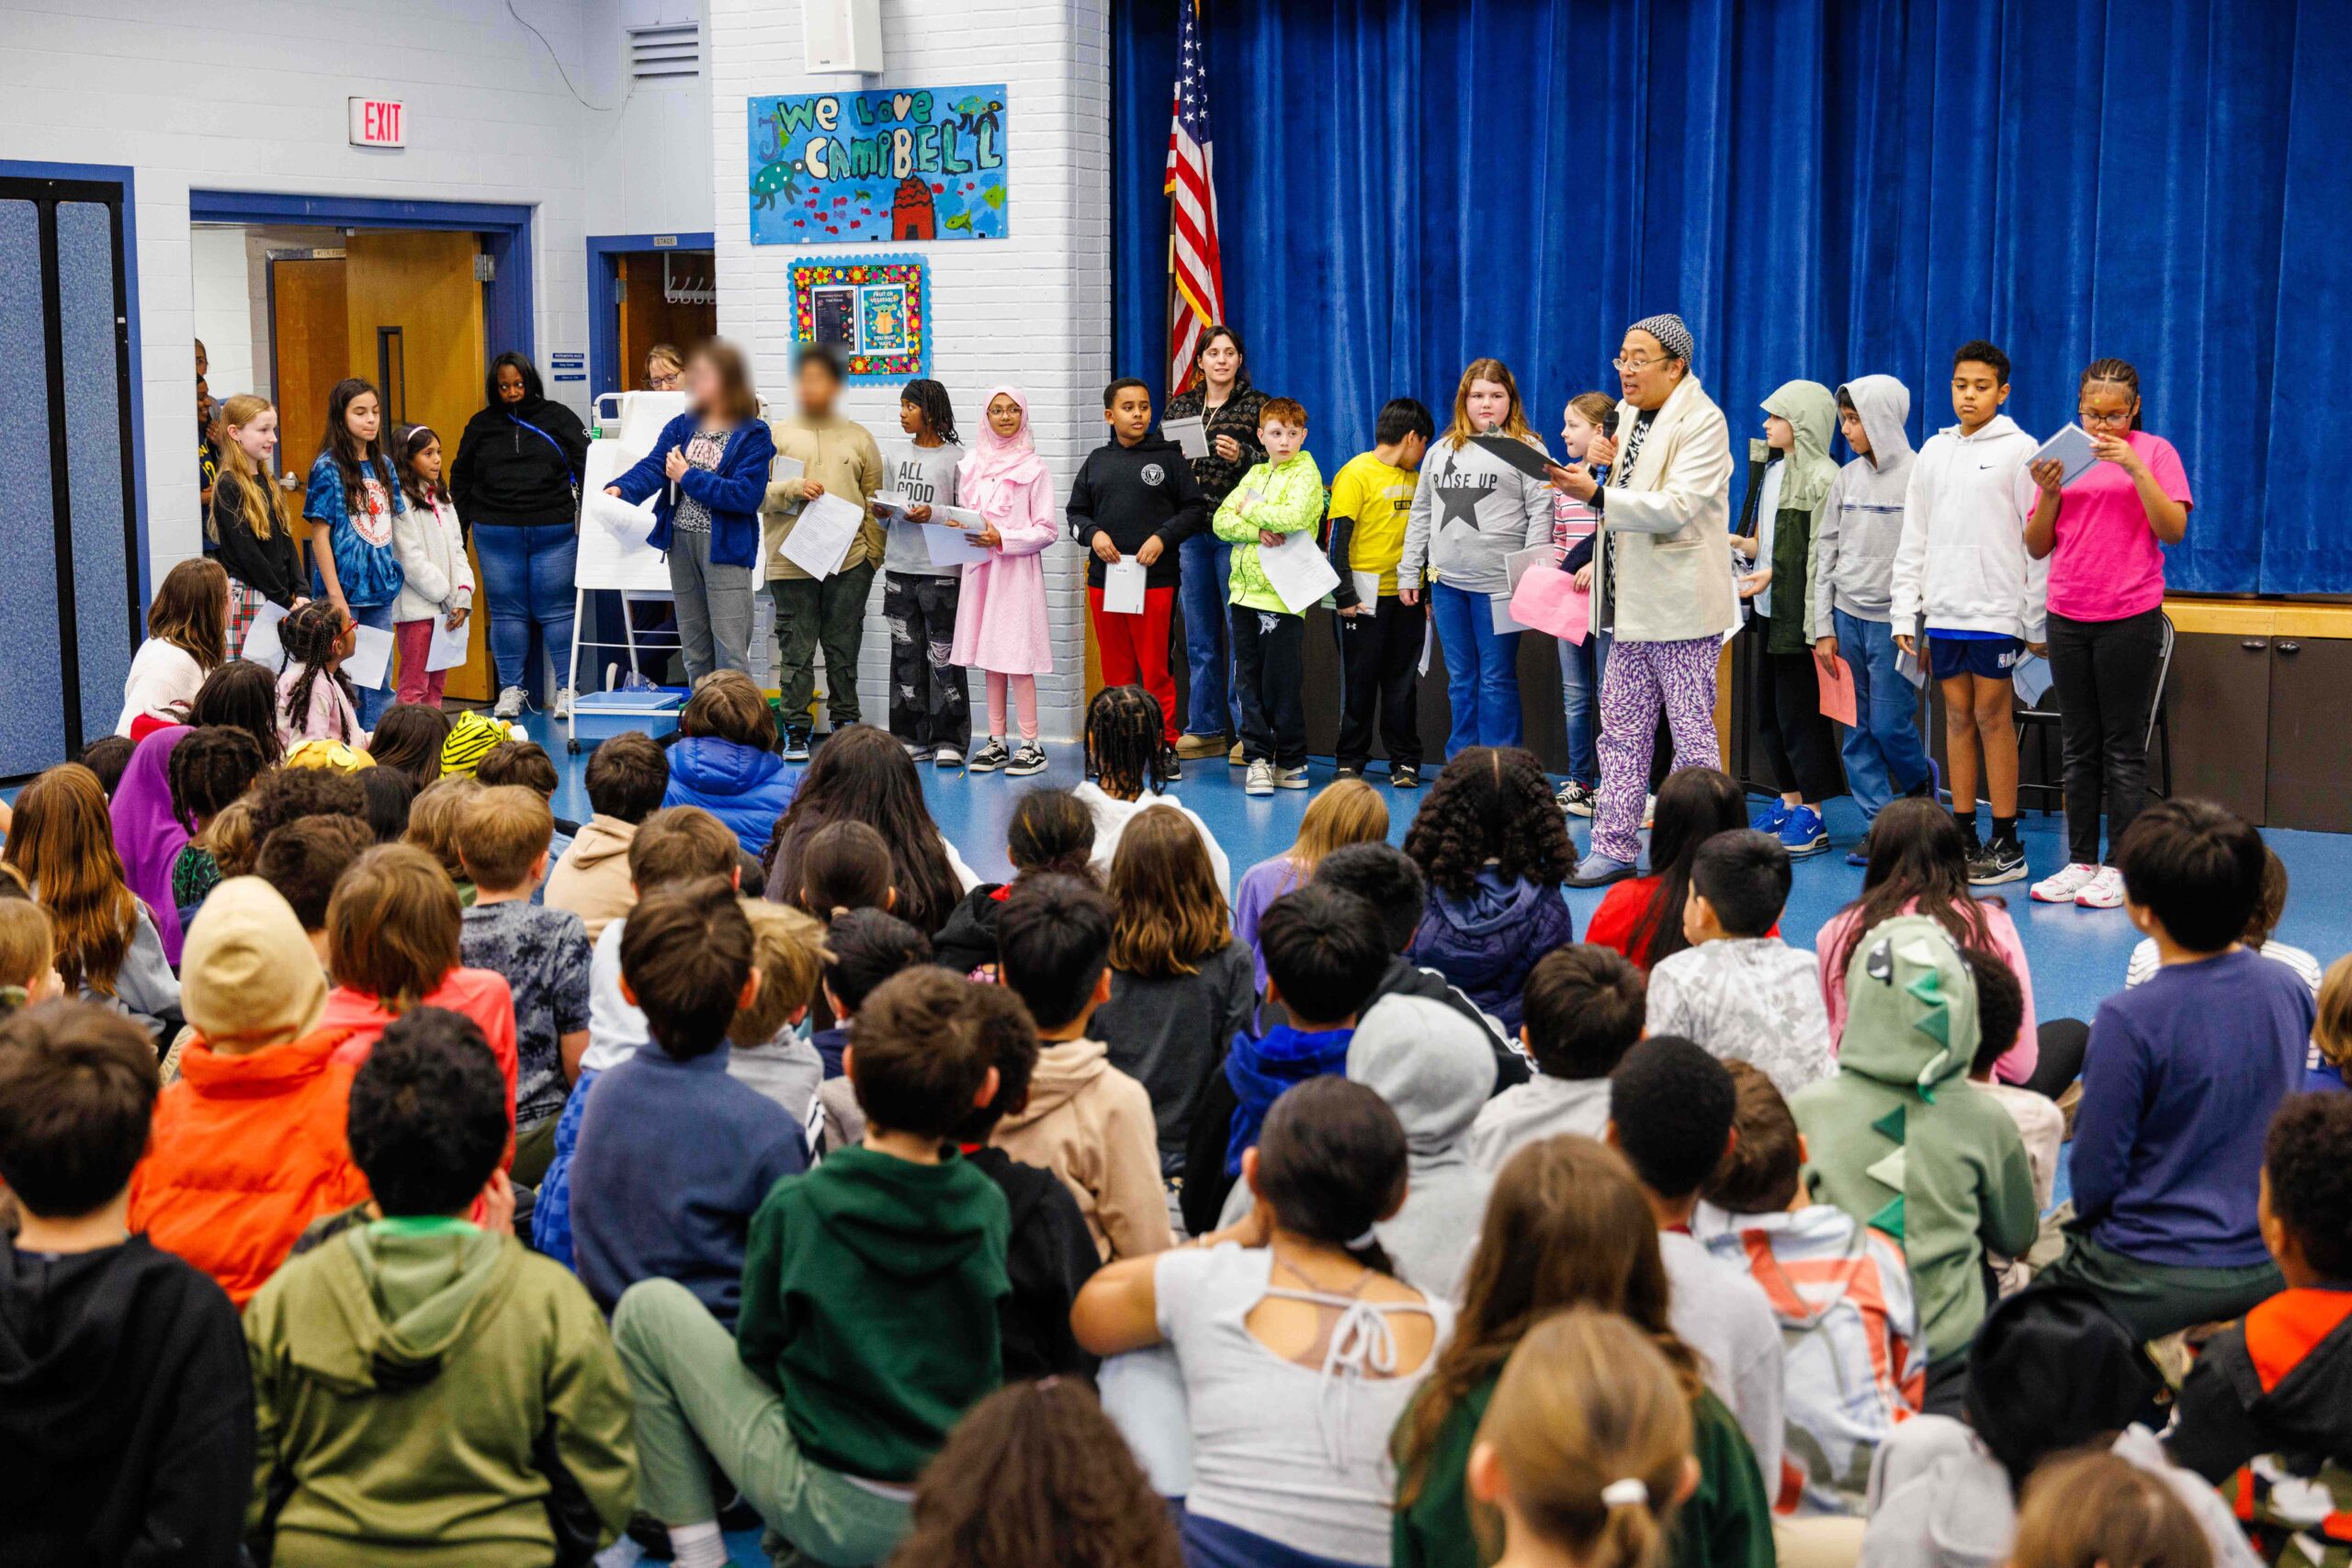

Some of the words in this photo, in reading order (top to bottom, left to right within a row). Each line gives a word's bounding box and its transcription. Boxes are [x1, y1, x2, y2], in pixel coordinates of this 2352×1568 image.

[365, 101, 401, 142] EXIT
[777, 96, 840, 134] We
[656, 237, 674, 245] STAGE
[898, 460, 923, 481] ALL
[1478, 473, 1498, 489] UP
